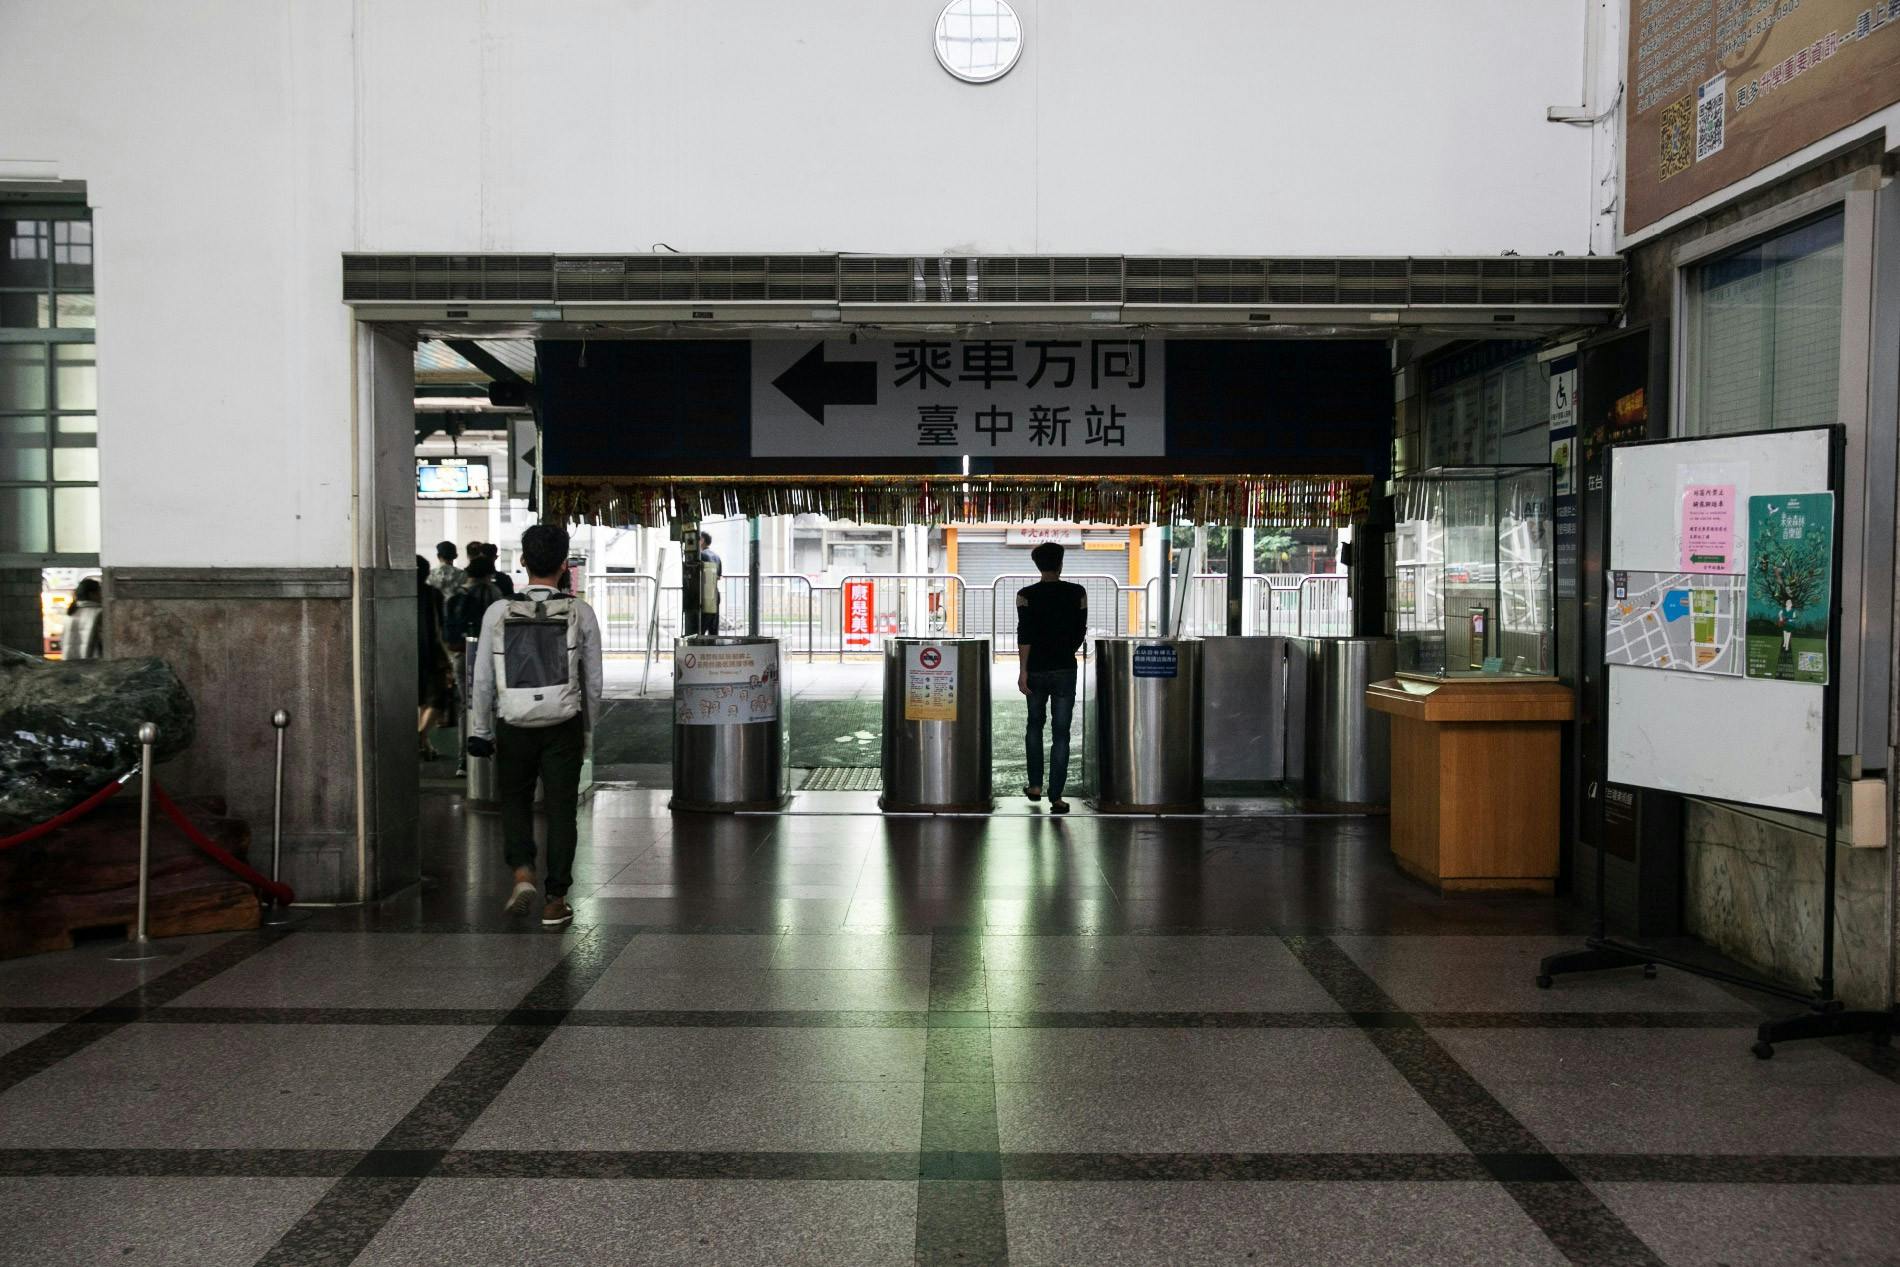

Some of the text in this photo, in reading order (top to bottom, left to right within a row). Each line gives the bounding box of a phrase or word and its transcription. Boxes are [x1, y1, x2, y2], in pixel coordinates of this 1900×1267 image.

[892, 338, 1146, 391] 乘車方向
[917, 403, 1127, 447] 臺中新站
[851, 585, 869, 632] 康是美
